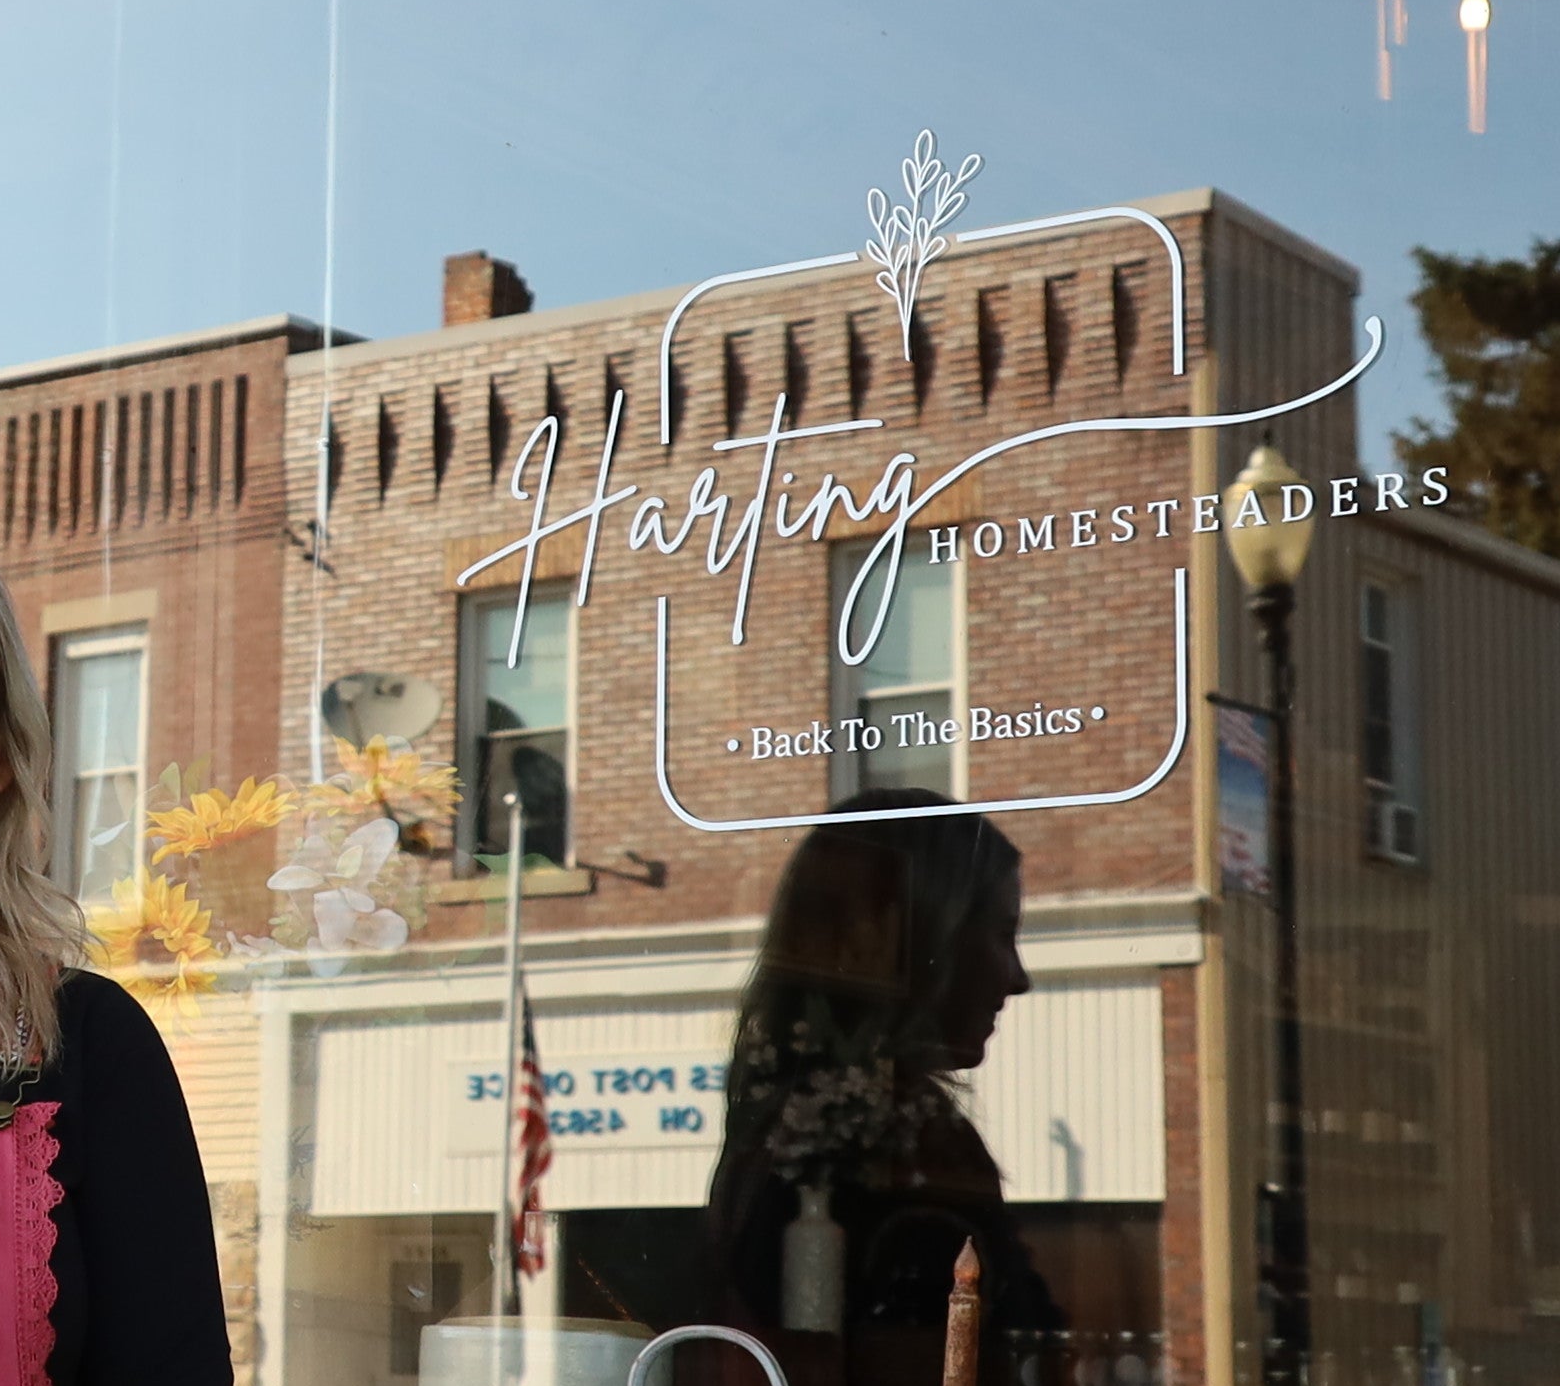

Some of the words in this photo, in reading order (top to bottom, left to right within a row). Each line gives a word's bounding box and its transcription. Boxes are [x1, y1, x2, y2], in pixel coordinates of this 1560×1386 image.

[460, 313, 1386, 669] Harting
[928, 464, 1452, 566] HOMESTEADERS
[750, 721, 834, 762] Back
[840, 716, 884, 753] To
[890, 710, 962, 750] The
[968, 701, 1082, 744] Basics
